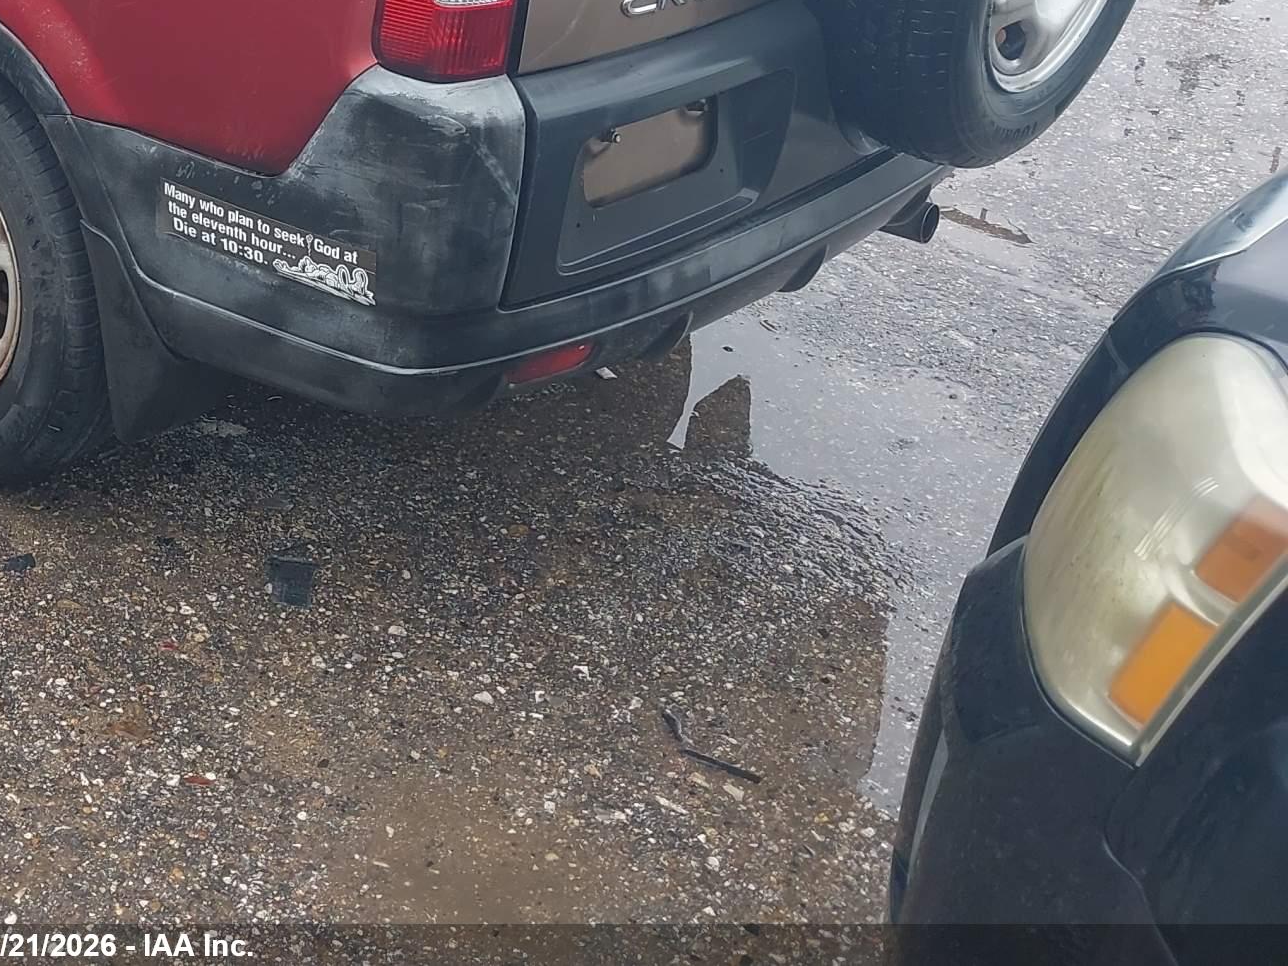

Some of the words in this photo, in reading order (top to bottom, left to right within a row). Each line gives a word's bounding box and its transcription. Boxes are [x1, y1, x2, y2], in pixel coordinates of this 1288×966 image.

[164, 182, 196, 208] Many
[200, 198, 224, 218] who
[228, 209, 254, 230] plan
[257, 219, 270, 235] to
[274, 227, 305, 248] seek
[314, 239, 340, 260] God
[344, 249, 358, 265] at
[168, 201, 187, 219] the
[192, 211, 247, 243] eleventh
[251, 234, 296, 260] hour...
[173, 217, 197, 238] Die
[202, 231, 217, 246] at
[220, 238, 268, 266] 10:30.
